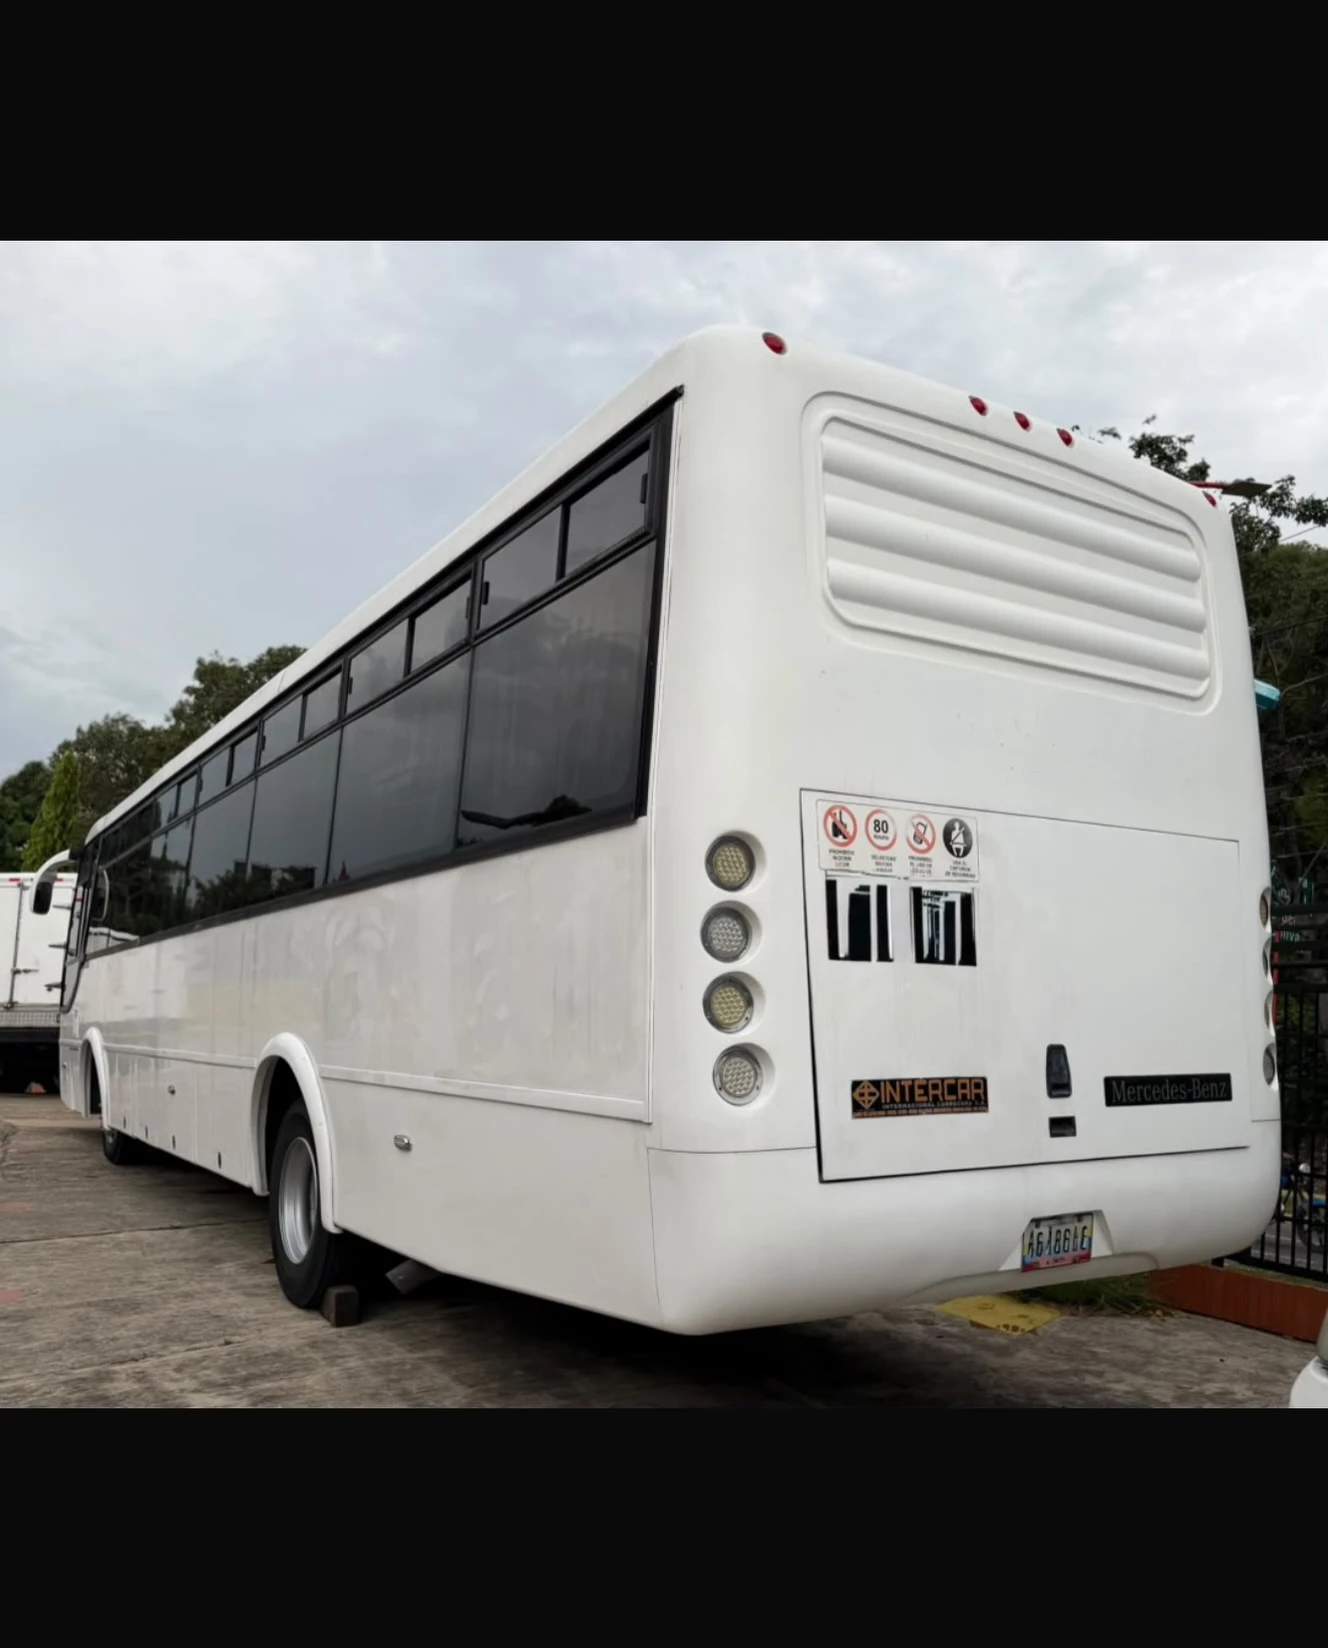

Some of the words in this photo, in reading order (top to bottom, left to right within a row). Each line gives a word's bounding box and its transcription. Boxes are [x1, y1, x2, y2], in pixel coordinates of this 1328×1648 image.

[873, 819, 889, 834] 80
[880, 1078, 985, 1103] INTERCAR
[1111, 1077, 1228, 1103] Mercedes-Benz
